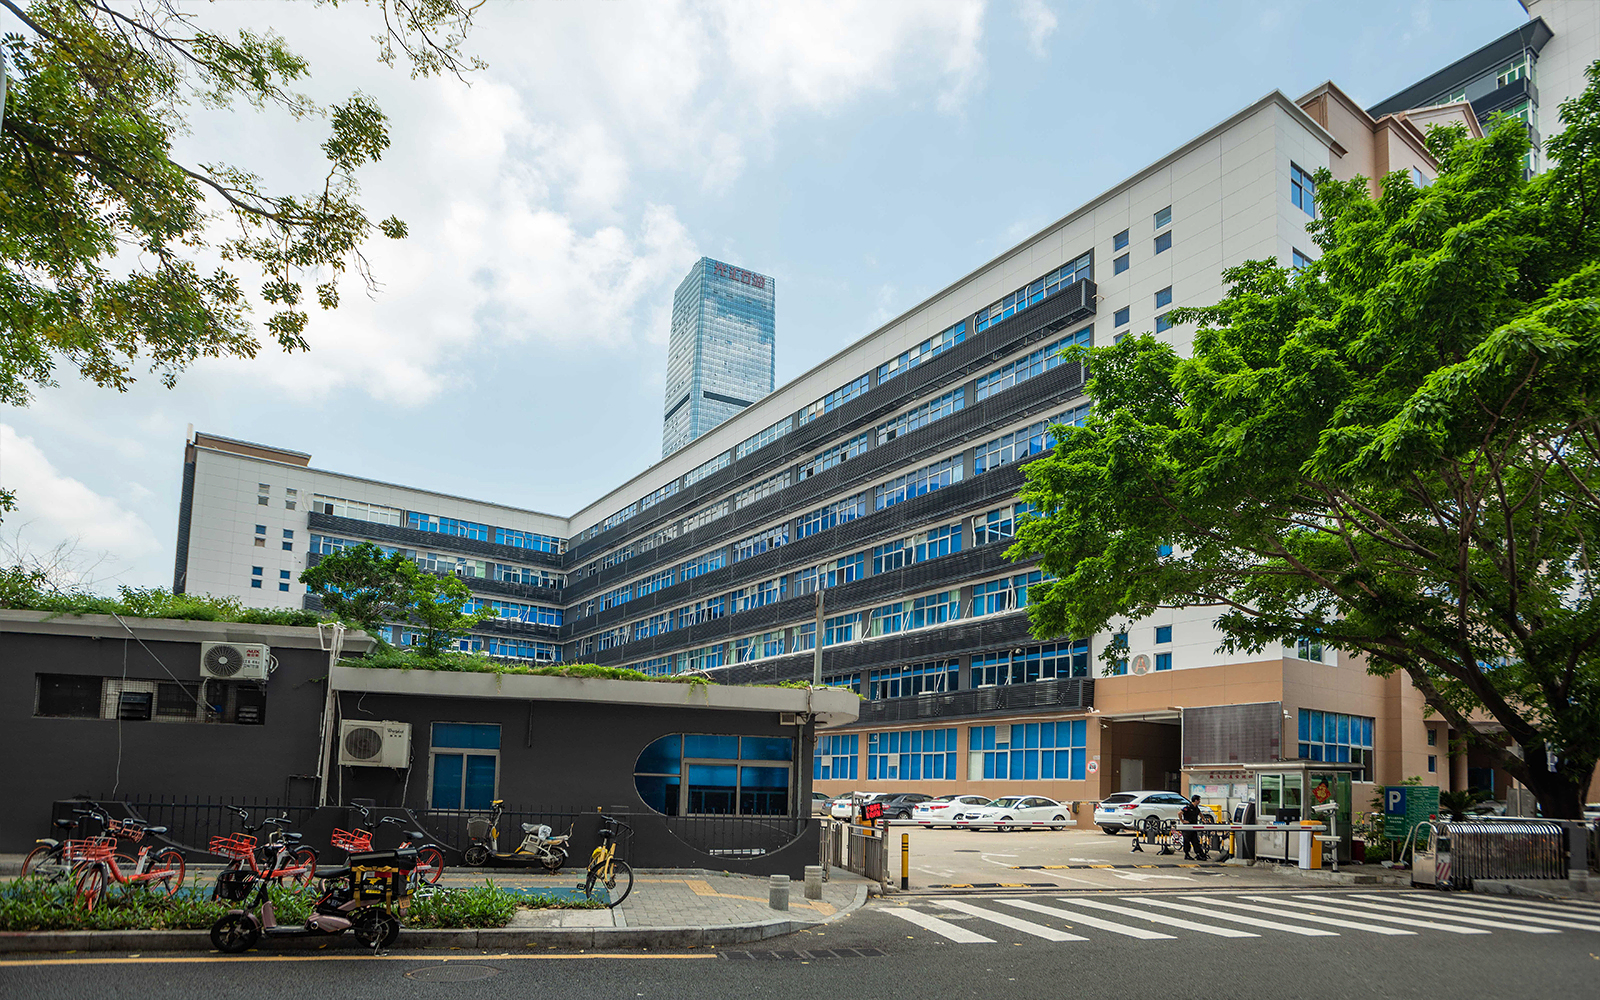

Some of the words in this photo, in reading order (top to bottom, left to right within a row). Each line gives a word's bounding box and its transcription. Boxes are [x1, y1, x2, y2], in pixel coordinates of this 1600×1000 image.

[713, 261, 766, 289] 光汇石油
[1134, 656, 1148, 673] A
[1388, 790, 1402, 811] P
